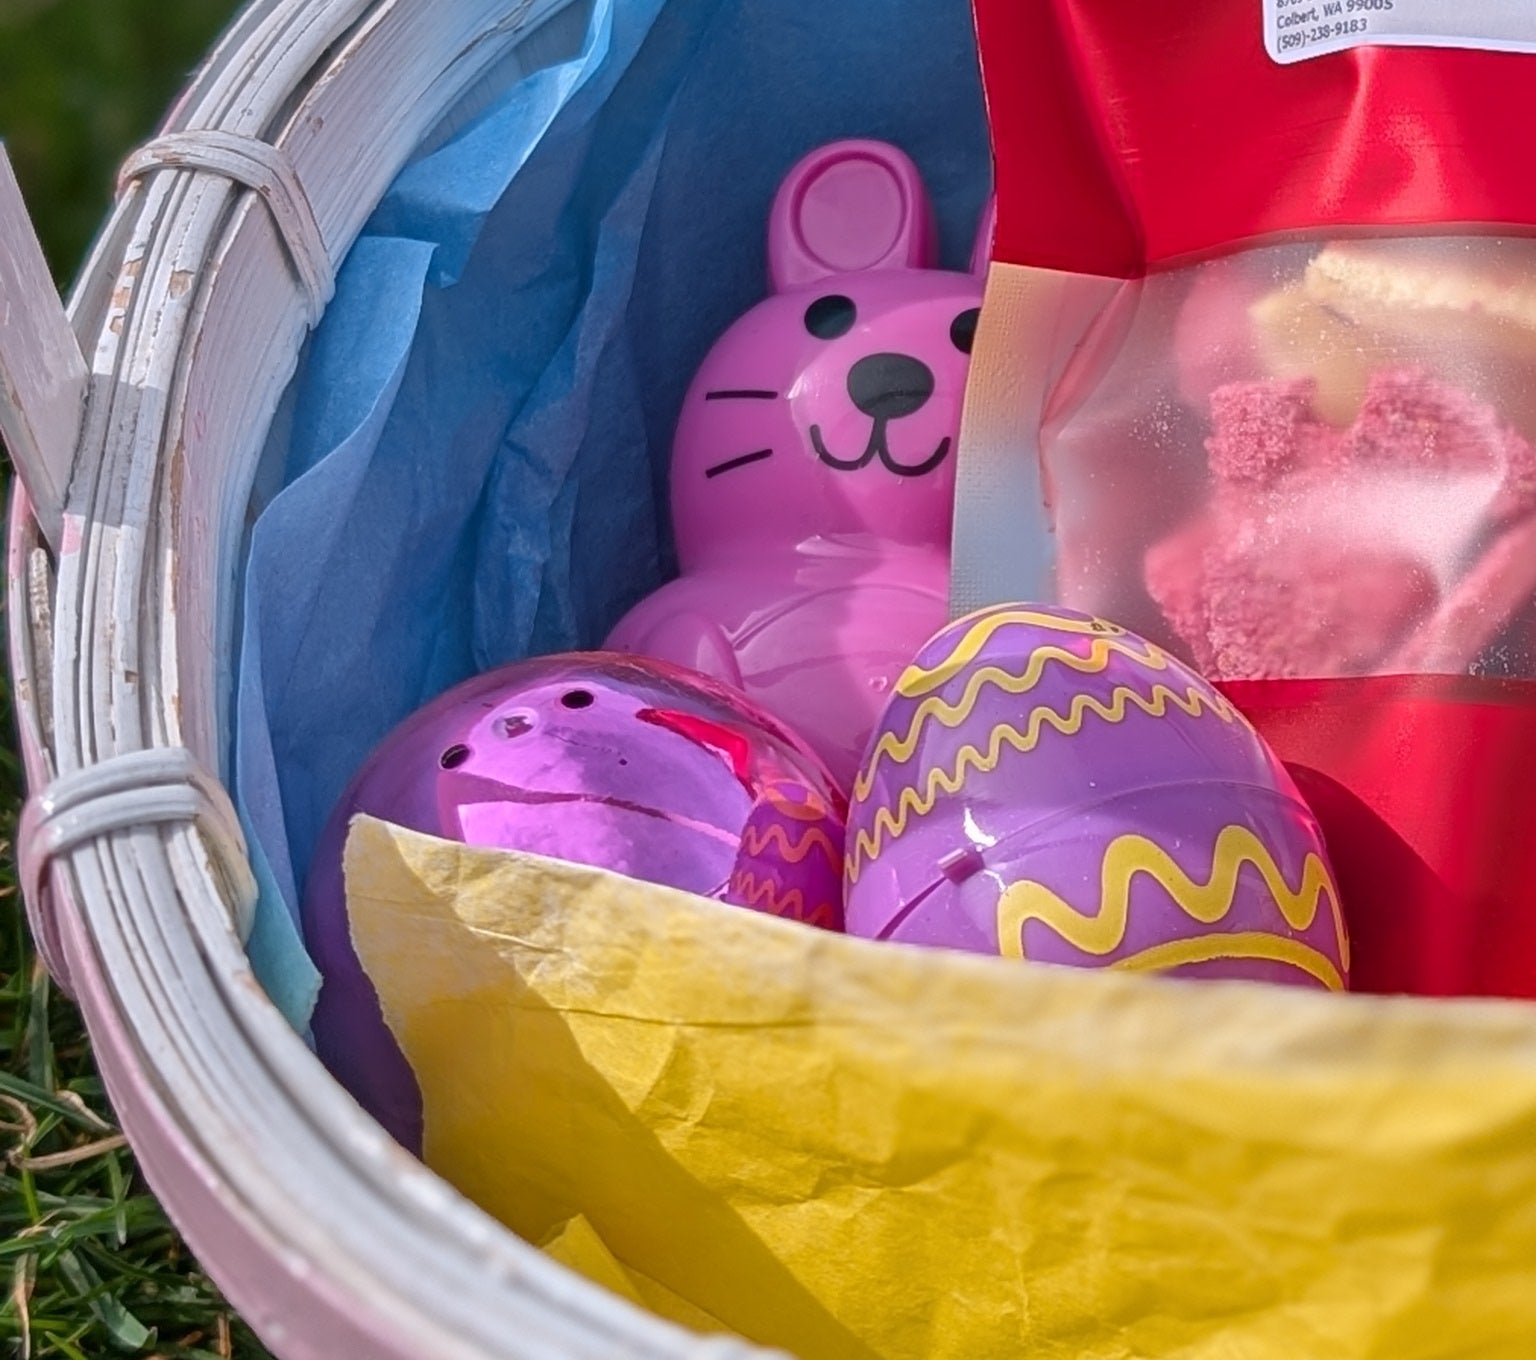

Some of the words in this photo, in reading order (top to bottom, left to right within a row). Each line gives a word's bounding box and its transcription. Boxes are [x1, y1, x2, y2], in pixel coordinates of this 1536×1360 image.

[1276, 8, 1319, 29] Colbert,
[1323, 1, 1342, 17] WA
[1276, 18, 1367, 53] (509)-238-9183
